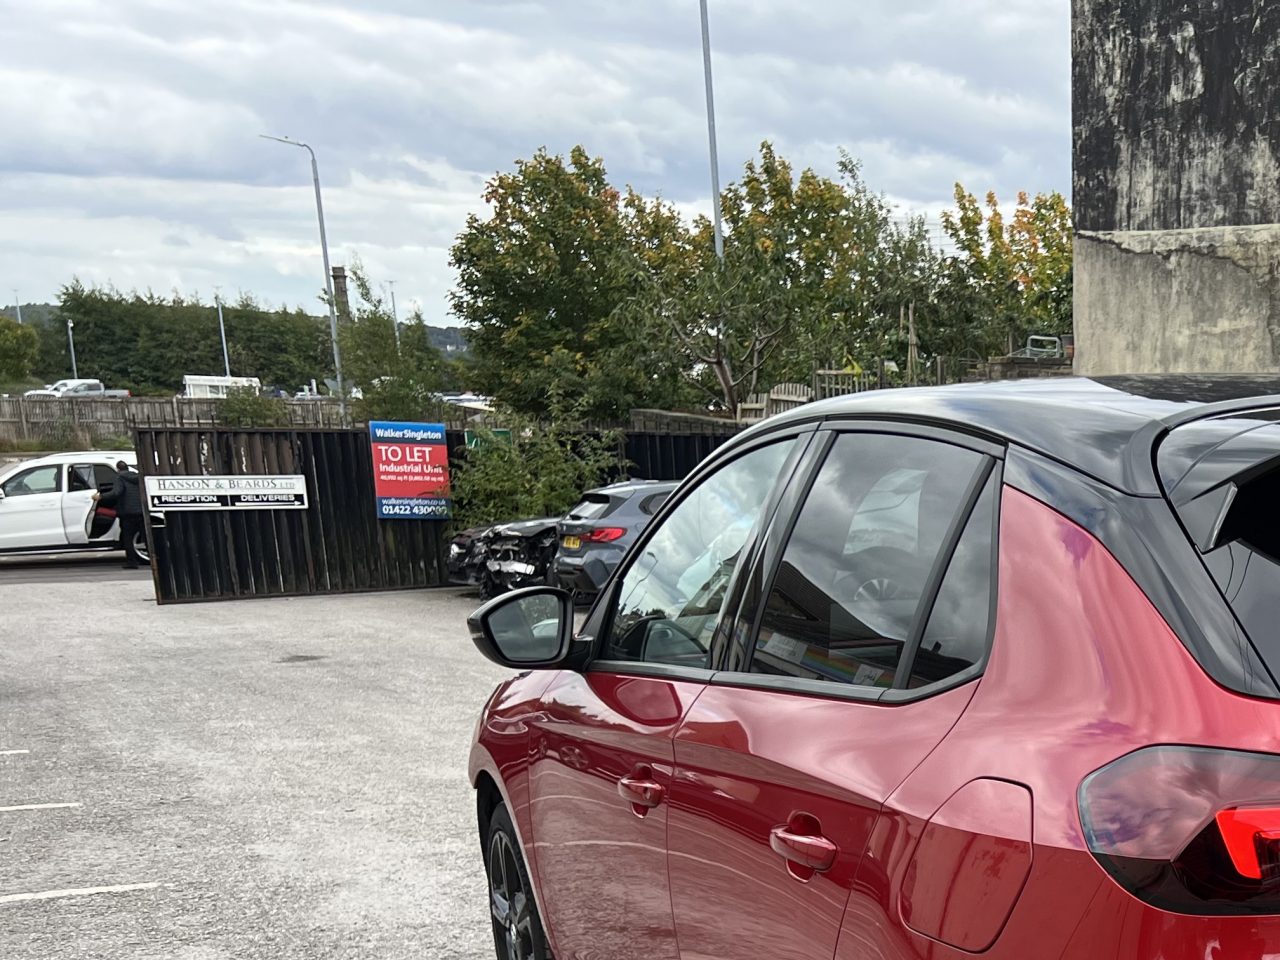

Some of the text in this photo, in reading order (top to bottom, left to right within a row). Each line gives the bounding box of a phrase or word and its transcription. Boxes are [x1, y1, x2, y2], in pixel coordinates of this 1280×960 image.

[375, 428, 442, 440] WalkerSingleton
[377, 446, 432, 462] TO LET
[379, 463, 422, 472] Industrial
[157, 479, 210, 490] HANSON
[214, 480, 224, 489] &
[228, 479, 278, 489] BEARDS
[382, 505, 411, 514] 01422
